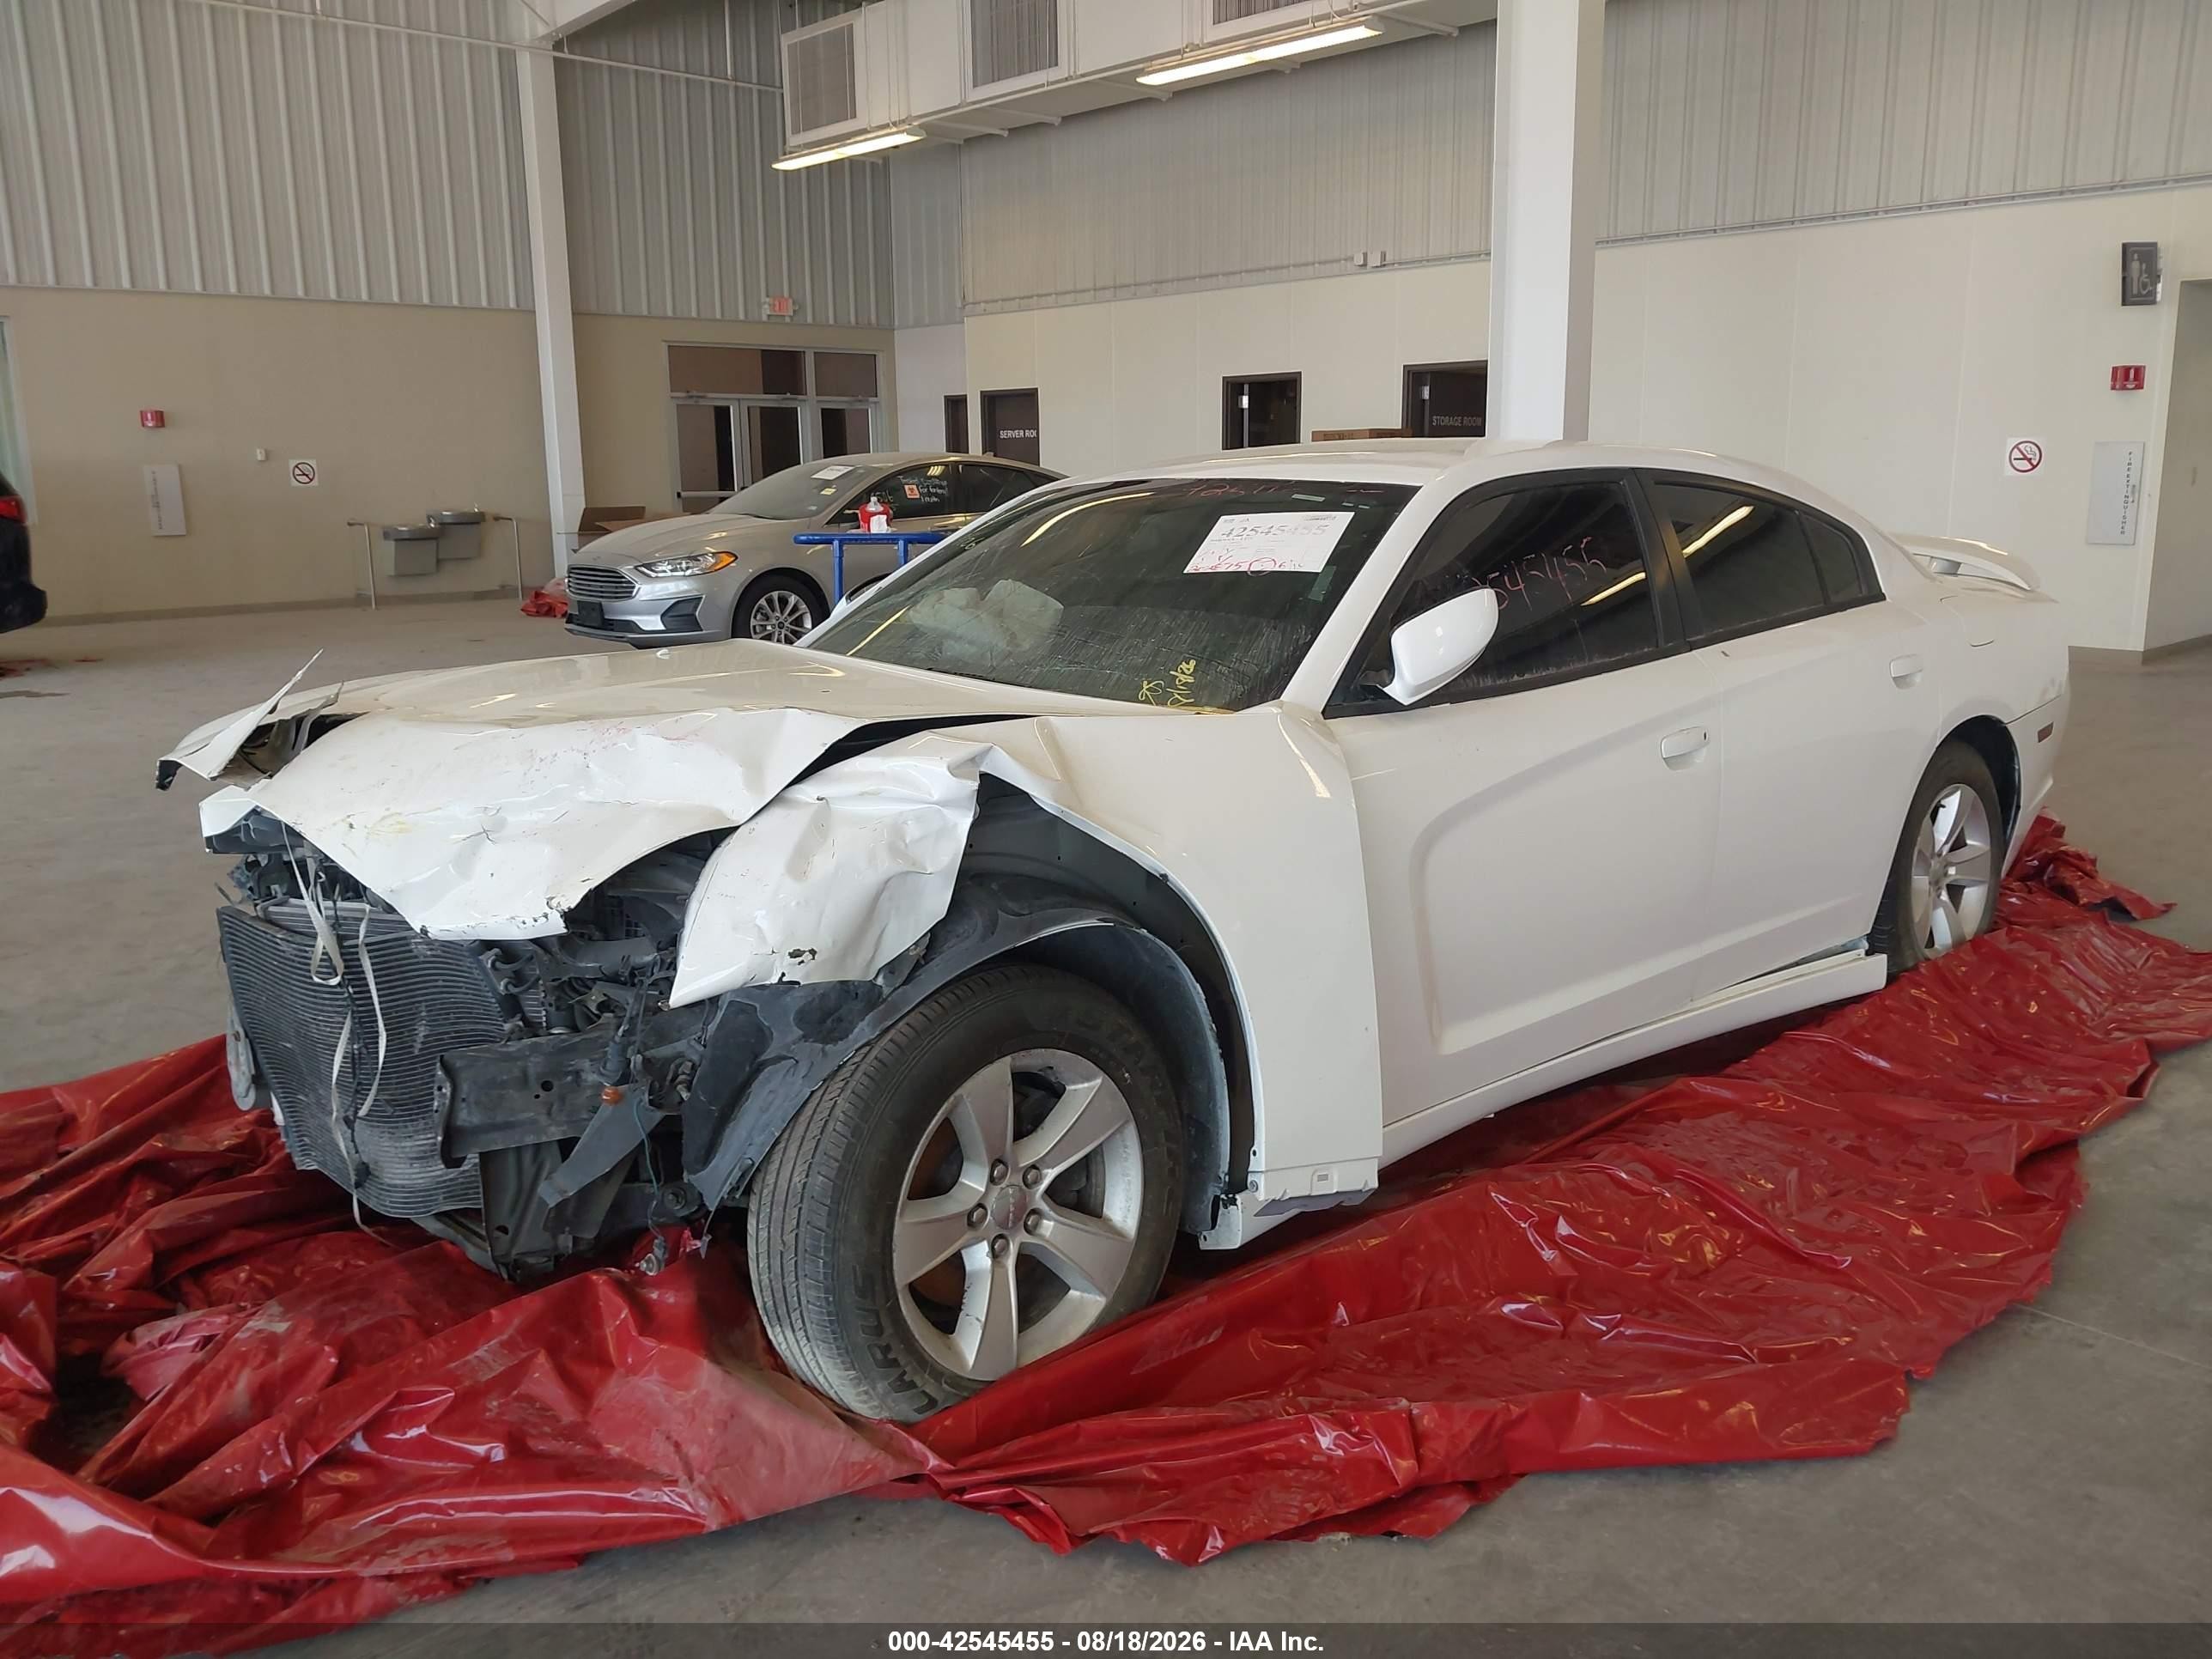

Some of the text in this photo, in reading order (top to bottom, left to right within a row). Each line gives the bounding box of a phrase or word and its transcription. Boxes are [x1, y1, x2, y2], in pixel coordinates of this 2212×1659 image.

[1431, 416, 1482, 426] STORAGE ROOM
[1000, 429, 1024, 439] SERVER
